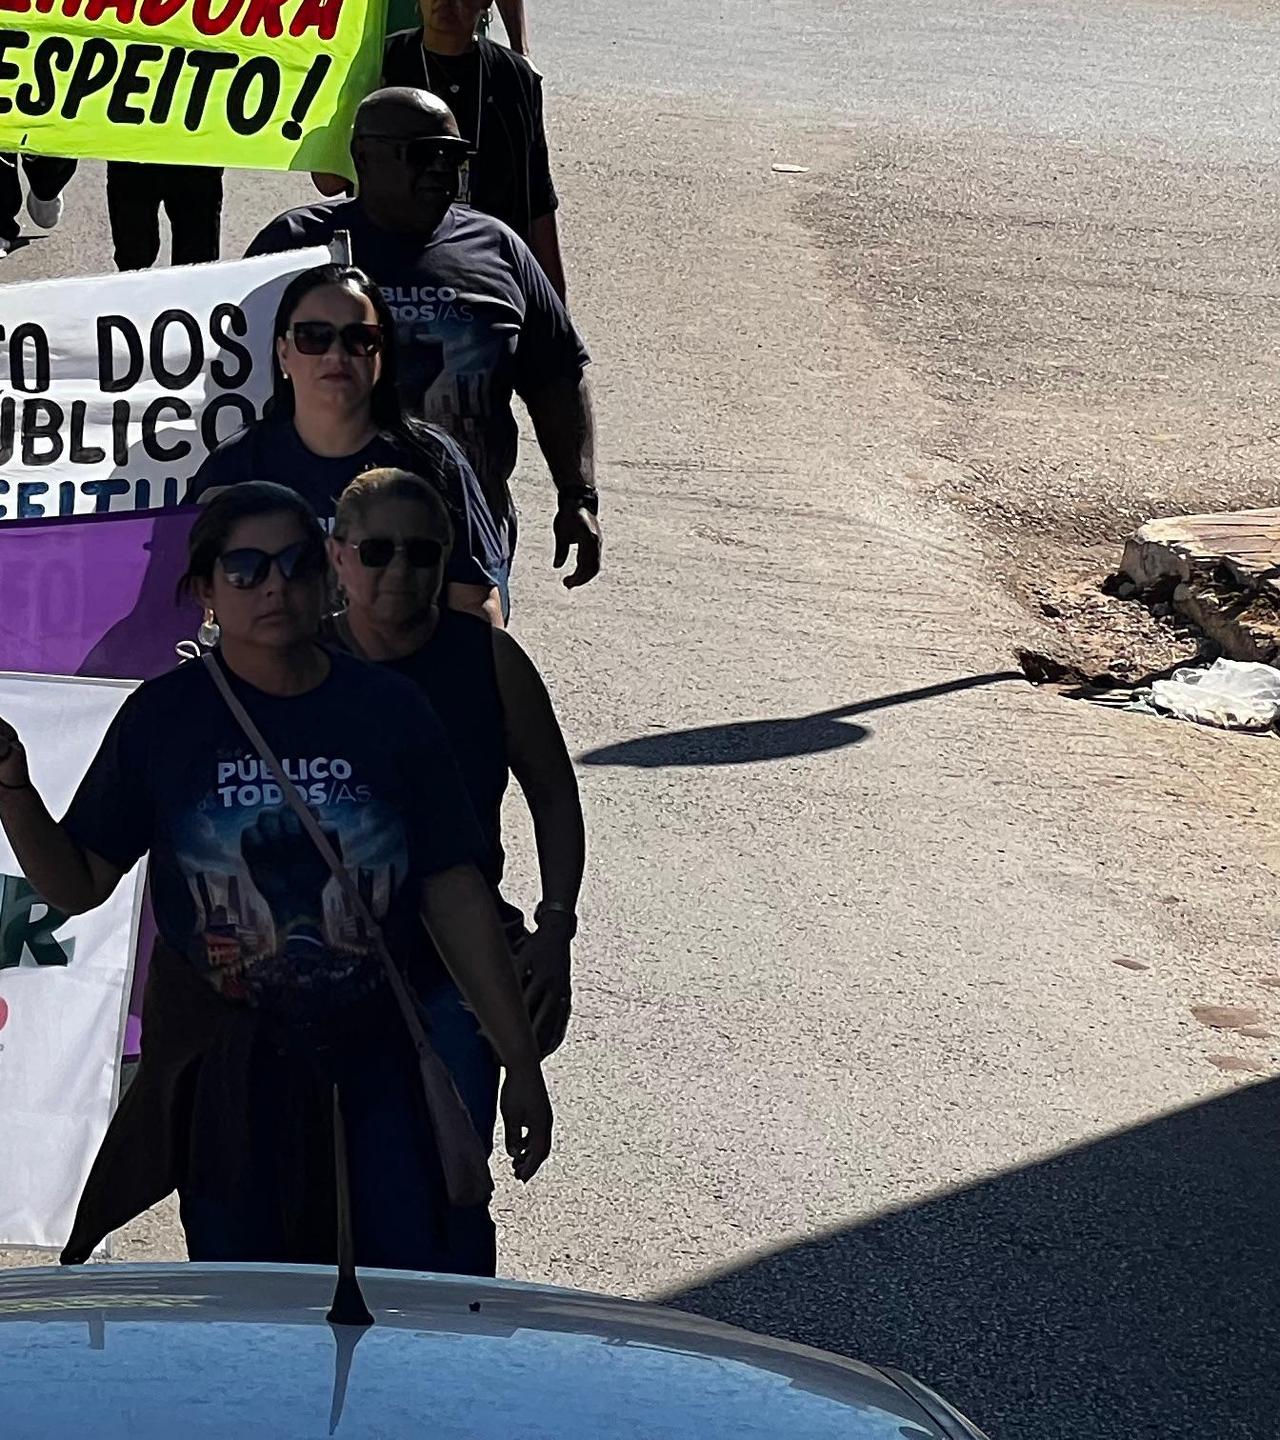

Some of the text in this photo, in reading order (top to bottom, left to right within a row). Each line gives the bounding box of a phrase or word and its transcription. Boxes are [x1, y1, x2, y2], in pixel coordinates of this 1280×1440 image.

[380, 286, 457, 302] BLICO
[388, 302, 474, 322] OS/AS
[97, 303, 252, 392] DOS
